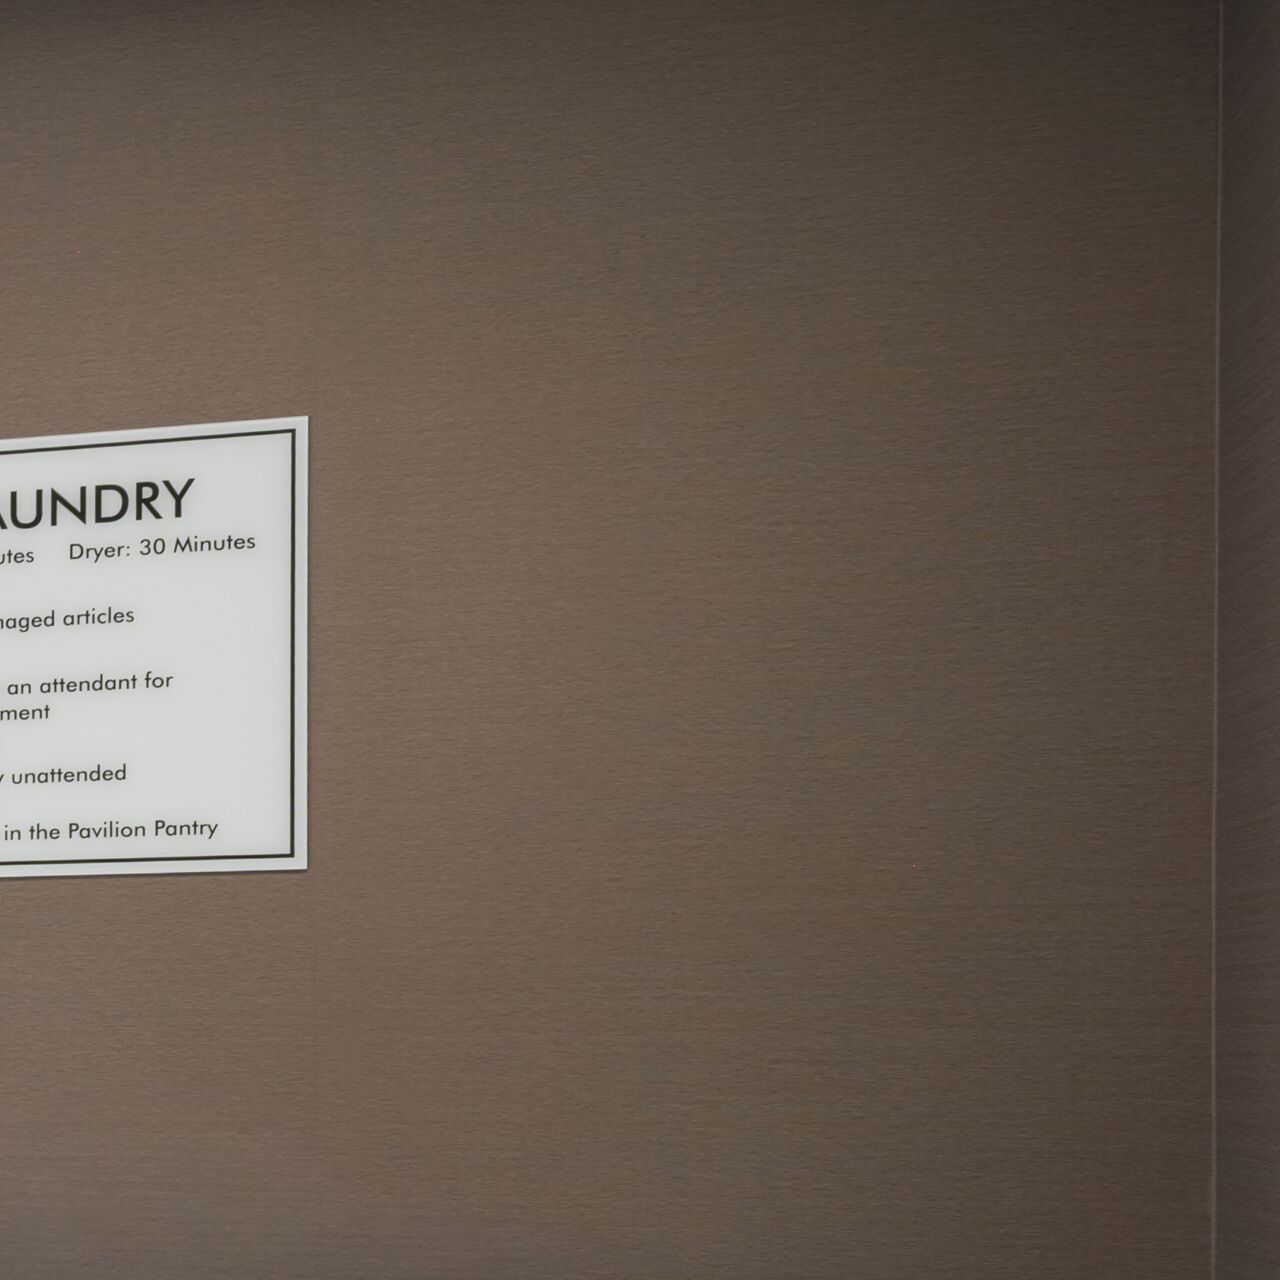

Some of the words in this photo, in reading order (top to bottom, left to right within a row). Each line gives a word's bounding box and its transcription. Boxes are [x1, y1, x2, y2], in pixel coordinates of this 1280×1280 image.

[69, 543, 130, 563] Dryer:
[139, 537, 166, 556] 30
[173, 535, 256, 553] Minutes
[62, 606, 135, 626] articles
[7, 683, 32, 696] an
[39, 673, 138, 694] attendant
[144, 671, 174, 689] for
[11, 763, 127, 785] unattended
[4, 824, 21, 841] in
[29, 823, 61, 840] the
[68, 820, 146, 839] Pavilion
[154, 819, 219, 840] Pantry
